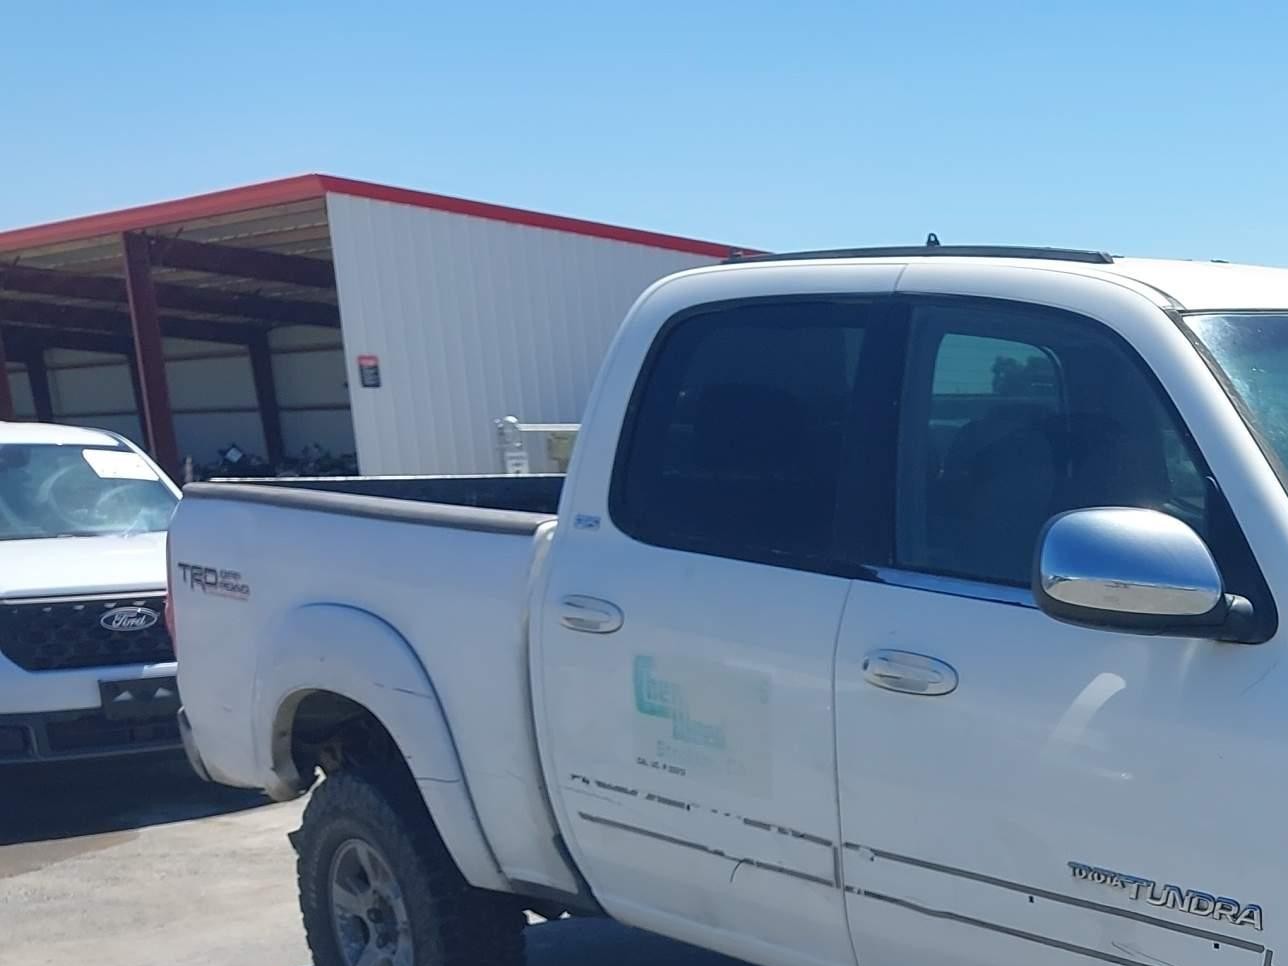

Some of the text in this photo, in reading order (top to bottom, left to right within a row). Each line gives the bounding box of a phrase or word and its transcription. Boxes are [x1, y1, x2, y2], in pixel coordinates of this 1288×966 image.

[177, 562, 217, 594] TRD
[1067, 861, 1264, 930] TOYOTA TUNDRA
